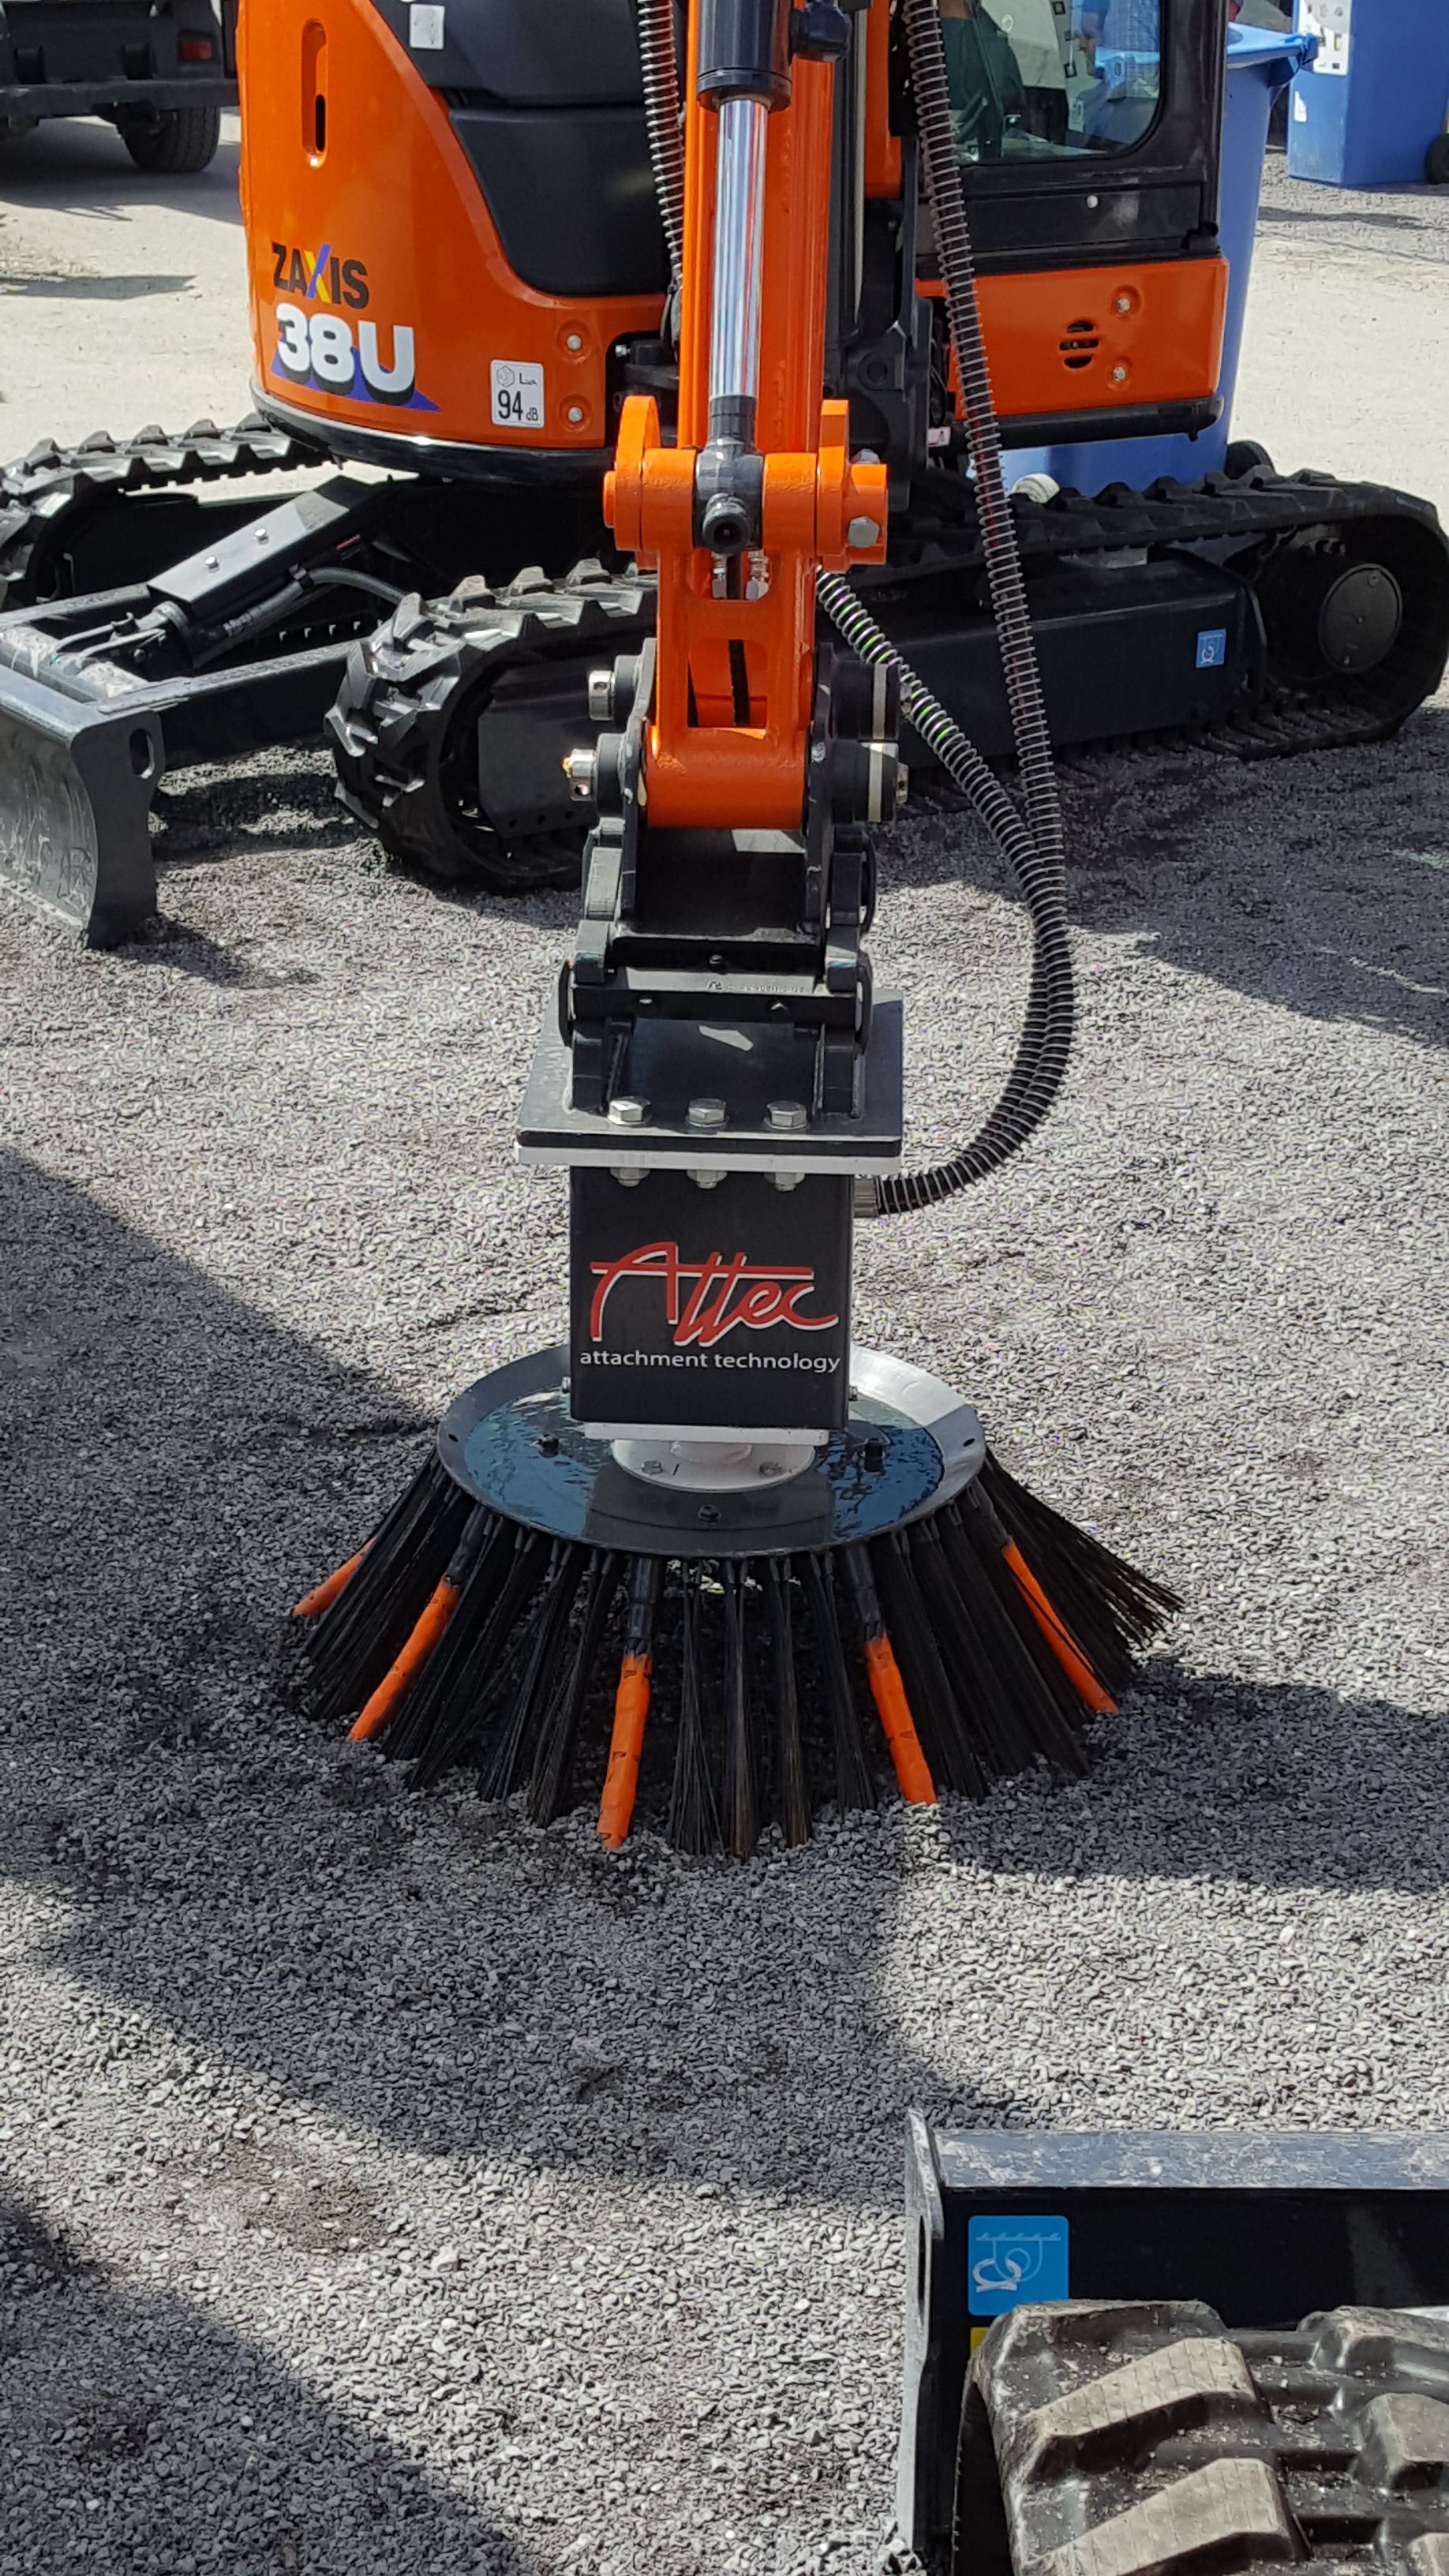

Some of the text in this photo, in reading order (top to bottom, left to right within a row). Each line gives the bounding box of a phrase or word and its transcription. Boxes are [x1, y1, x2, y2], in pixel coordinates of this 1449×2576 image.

[271, 242, 370, 309] ZAXIS
[276, 303, 415, 399] 38U
[498, 389, 539, 421] 94 dB
[590, 1241, 839, 1347] Attec
[580, 1350, 841, 1372] attachment technology
